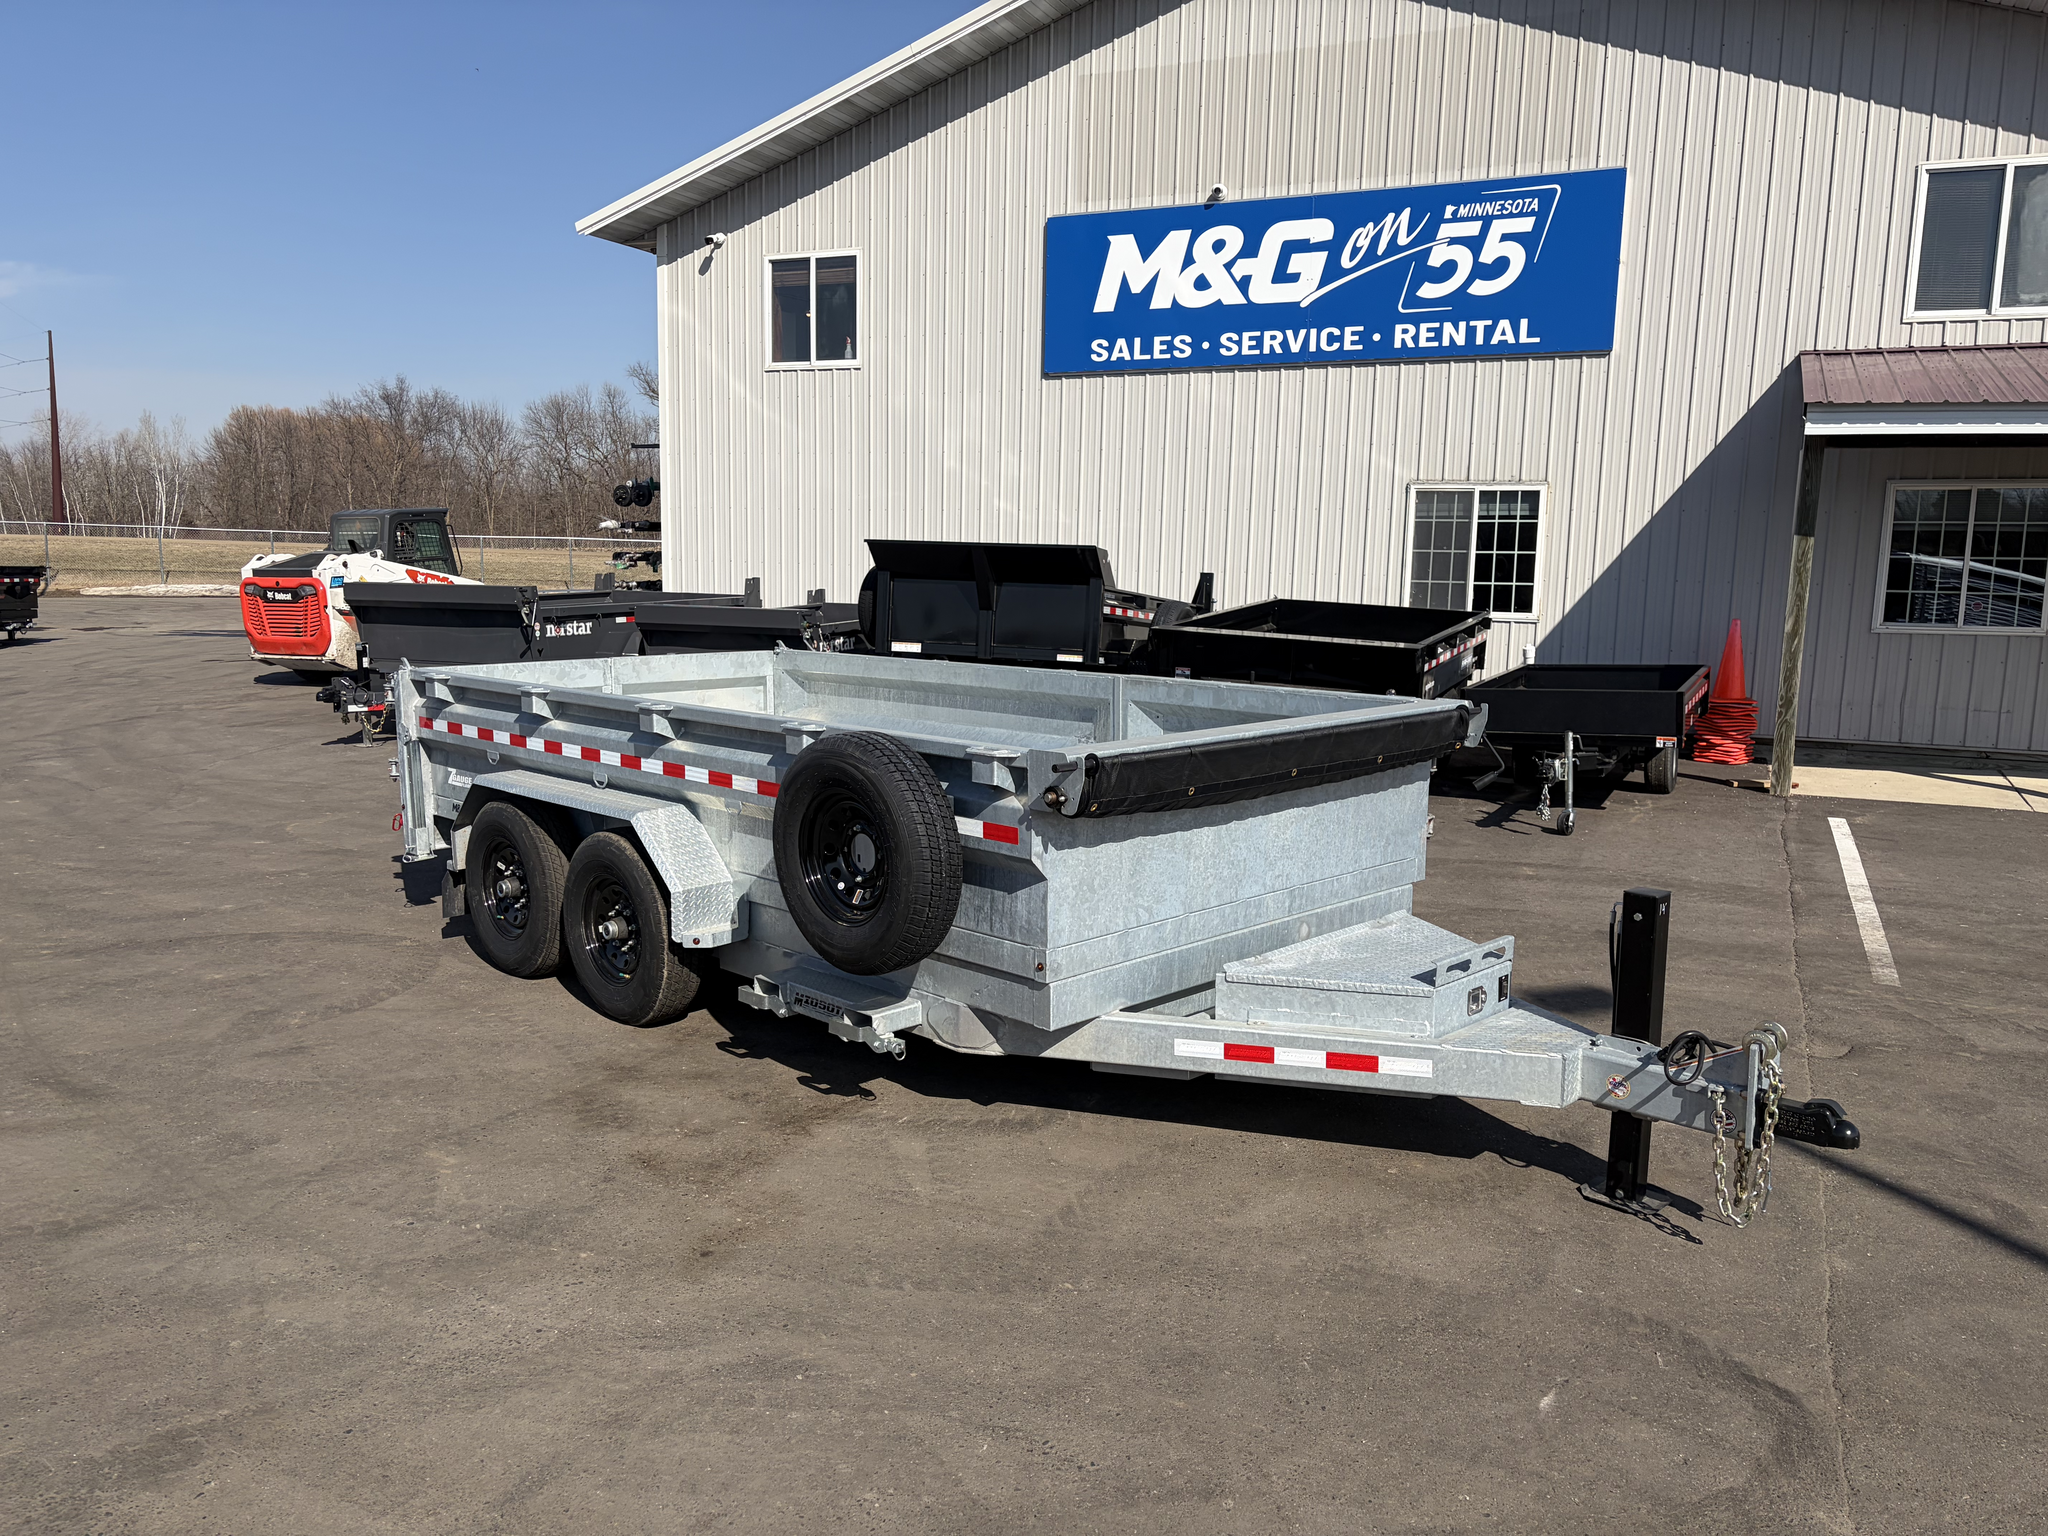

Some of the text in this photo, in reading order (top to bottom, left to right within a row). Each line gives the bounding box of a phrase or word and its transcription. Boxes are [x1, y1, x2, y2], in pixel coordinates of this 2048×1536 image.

[1457, 198, 1539, 218] MINNESOTA
[1092, 207, 1537, 313] M&G on 55
[1090, 318, 1541, 362] SALES SERVICE RENTAL
[452, 774, 473, 785] GAUGE
